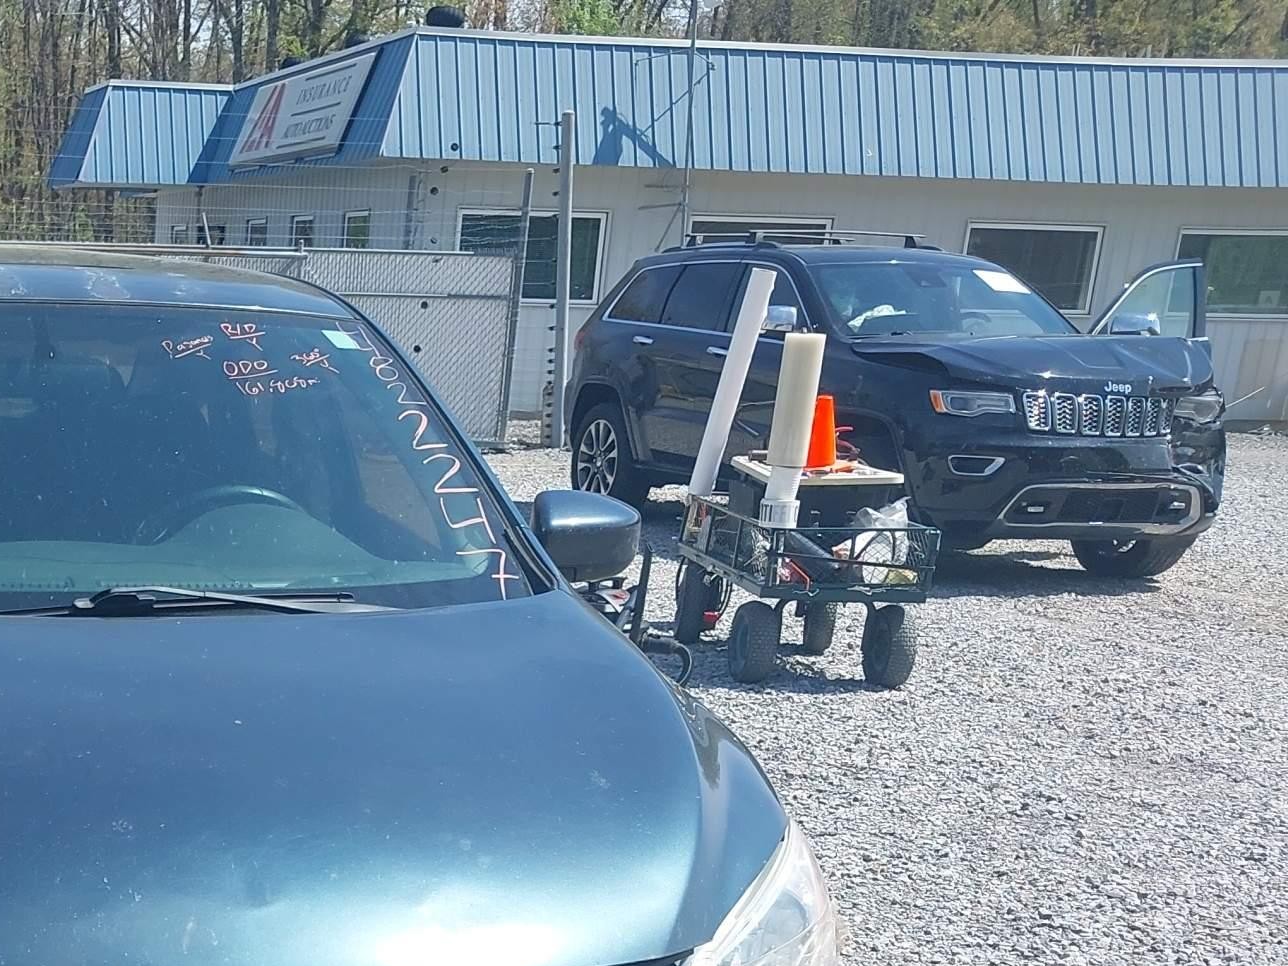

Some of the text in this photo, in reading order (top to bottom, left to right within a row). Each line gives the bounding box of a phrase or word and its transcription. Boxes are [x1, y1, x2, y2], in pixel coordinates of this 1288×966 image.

[296, 75, 353, 105] INSURANCE
[223, 360, 268, 377] ODO
[1104, 380, 1132, 395] Jeep
